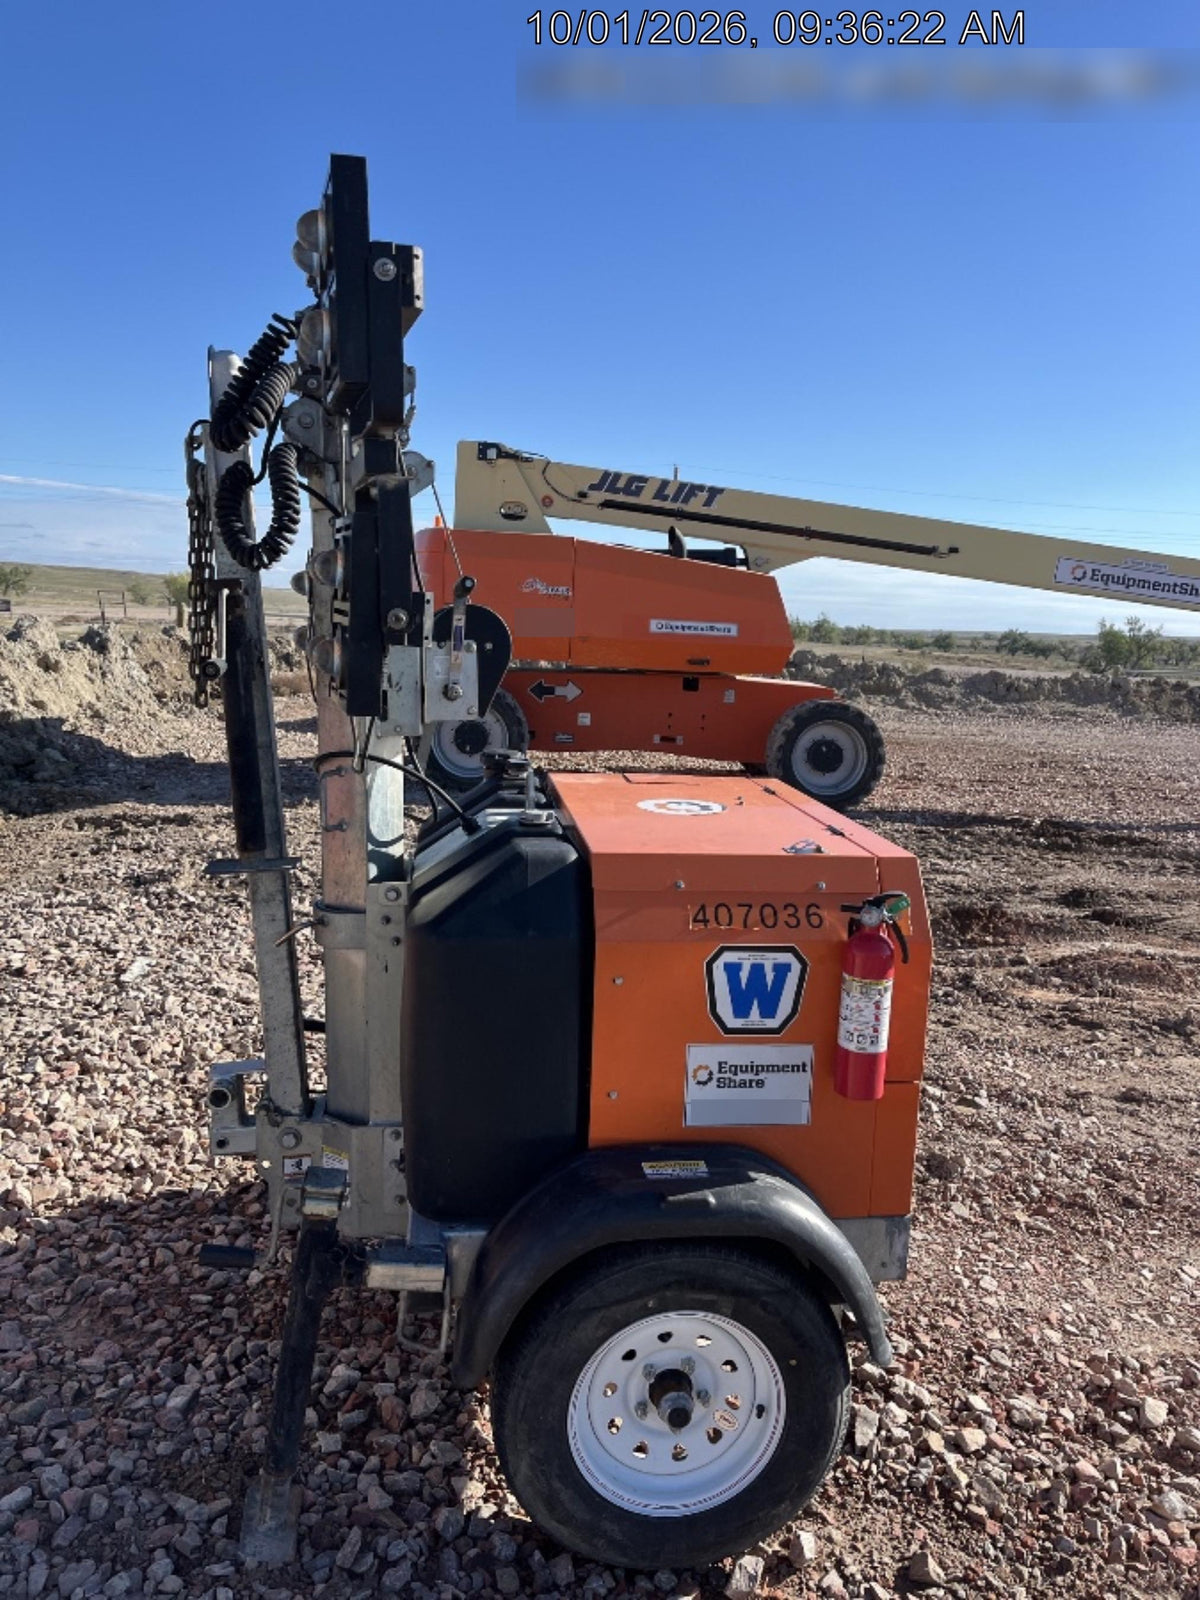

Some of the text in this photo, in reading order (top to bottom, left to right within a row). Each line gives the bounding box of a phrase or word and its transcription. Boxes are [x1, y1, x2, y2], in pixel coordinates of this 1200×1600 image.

[588, 469, 726, 508] JLG LIFT
[692, 902, 824, 929] 407036
[723, 961, 792, 1020] W
[717, 1060, 808, 1077] Equipment
[716, 1077, 766, 1089] Share
